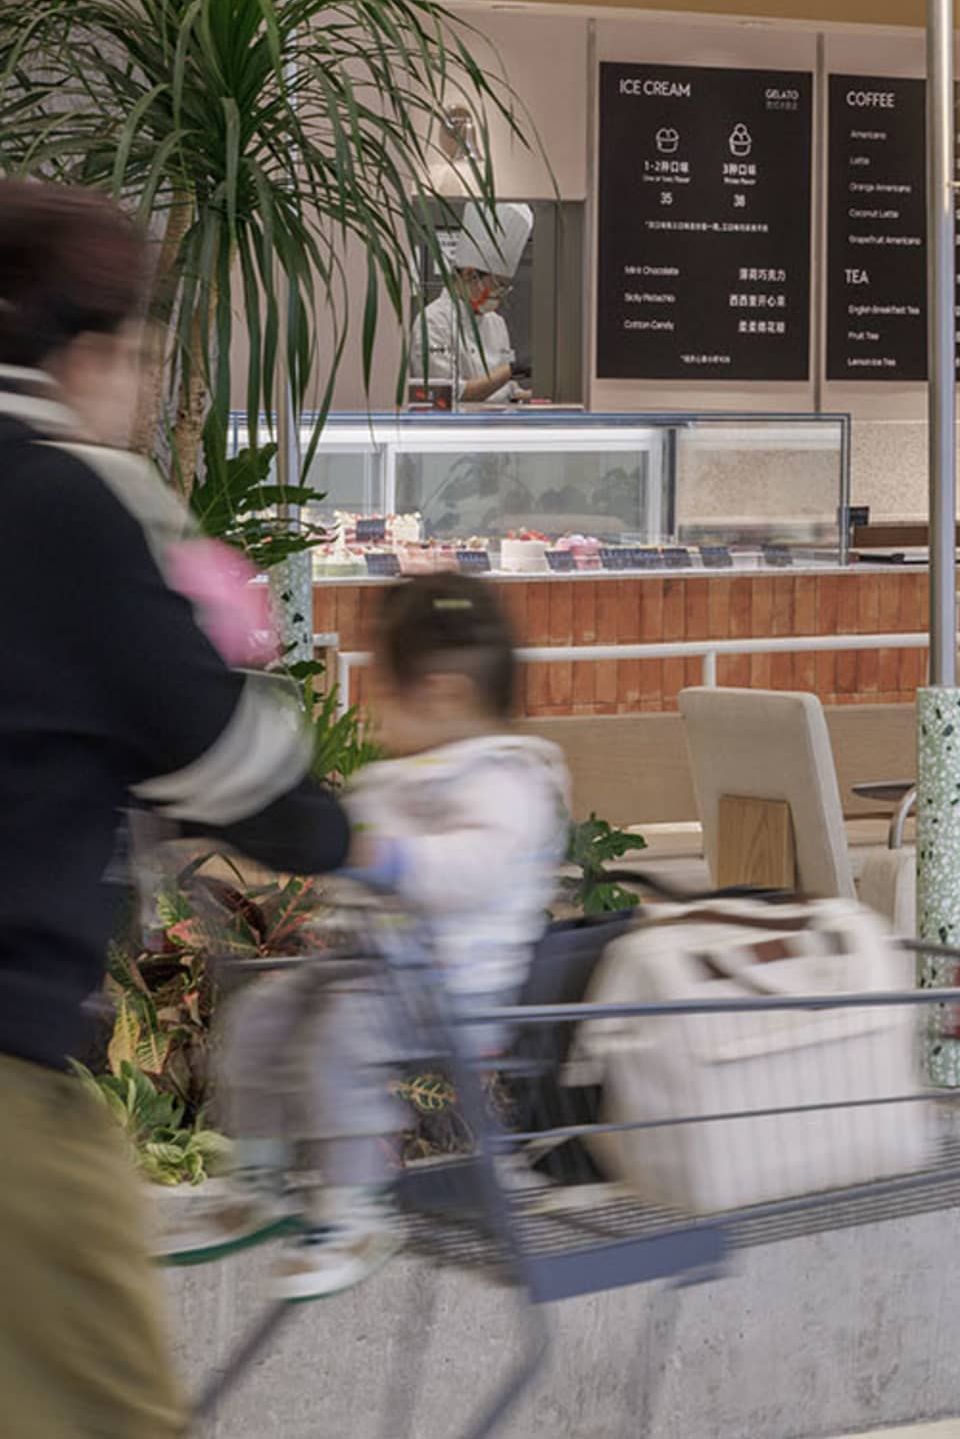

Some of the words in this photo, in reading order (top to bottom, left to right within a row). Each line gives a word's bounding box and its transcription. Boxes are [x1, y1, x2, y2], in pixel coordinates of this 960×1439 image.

[620, 79, 641, 94] ICE
[643, 80, 691, 97] CREAM
[765, 89, 799, 99] GELATO
[846, 91, 896, 108] COFFEE
[850, 130, 887, 140] Americano
[850, 156, 870, 166] Latte
[876, 184, 912, 194] Americano
[660, 191, 673, 205] 35
[733, 194, 746, 208] 38
[849, 209, 879, 219] Coconut
[879, 210, 899, 219] Latte
[848, 235, 885, 245] Grapefruit
[885, 236, 922, 246] Americano
[845, 269, 870, 284] TEA
[907, 306, 920, 315] Tea
[848, 332, 865, 341] Fruit
[866, 332, 880, 341] Tea
